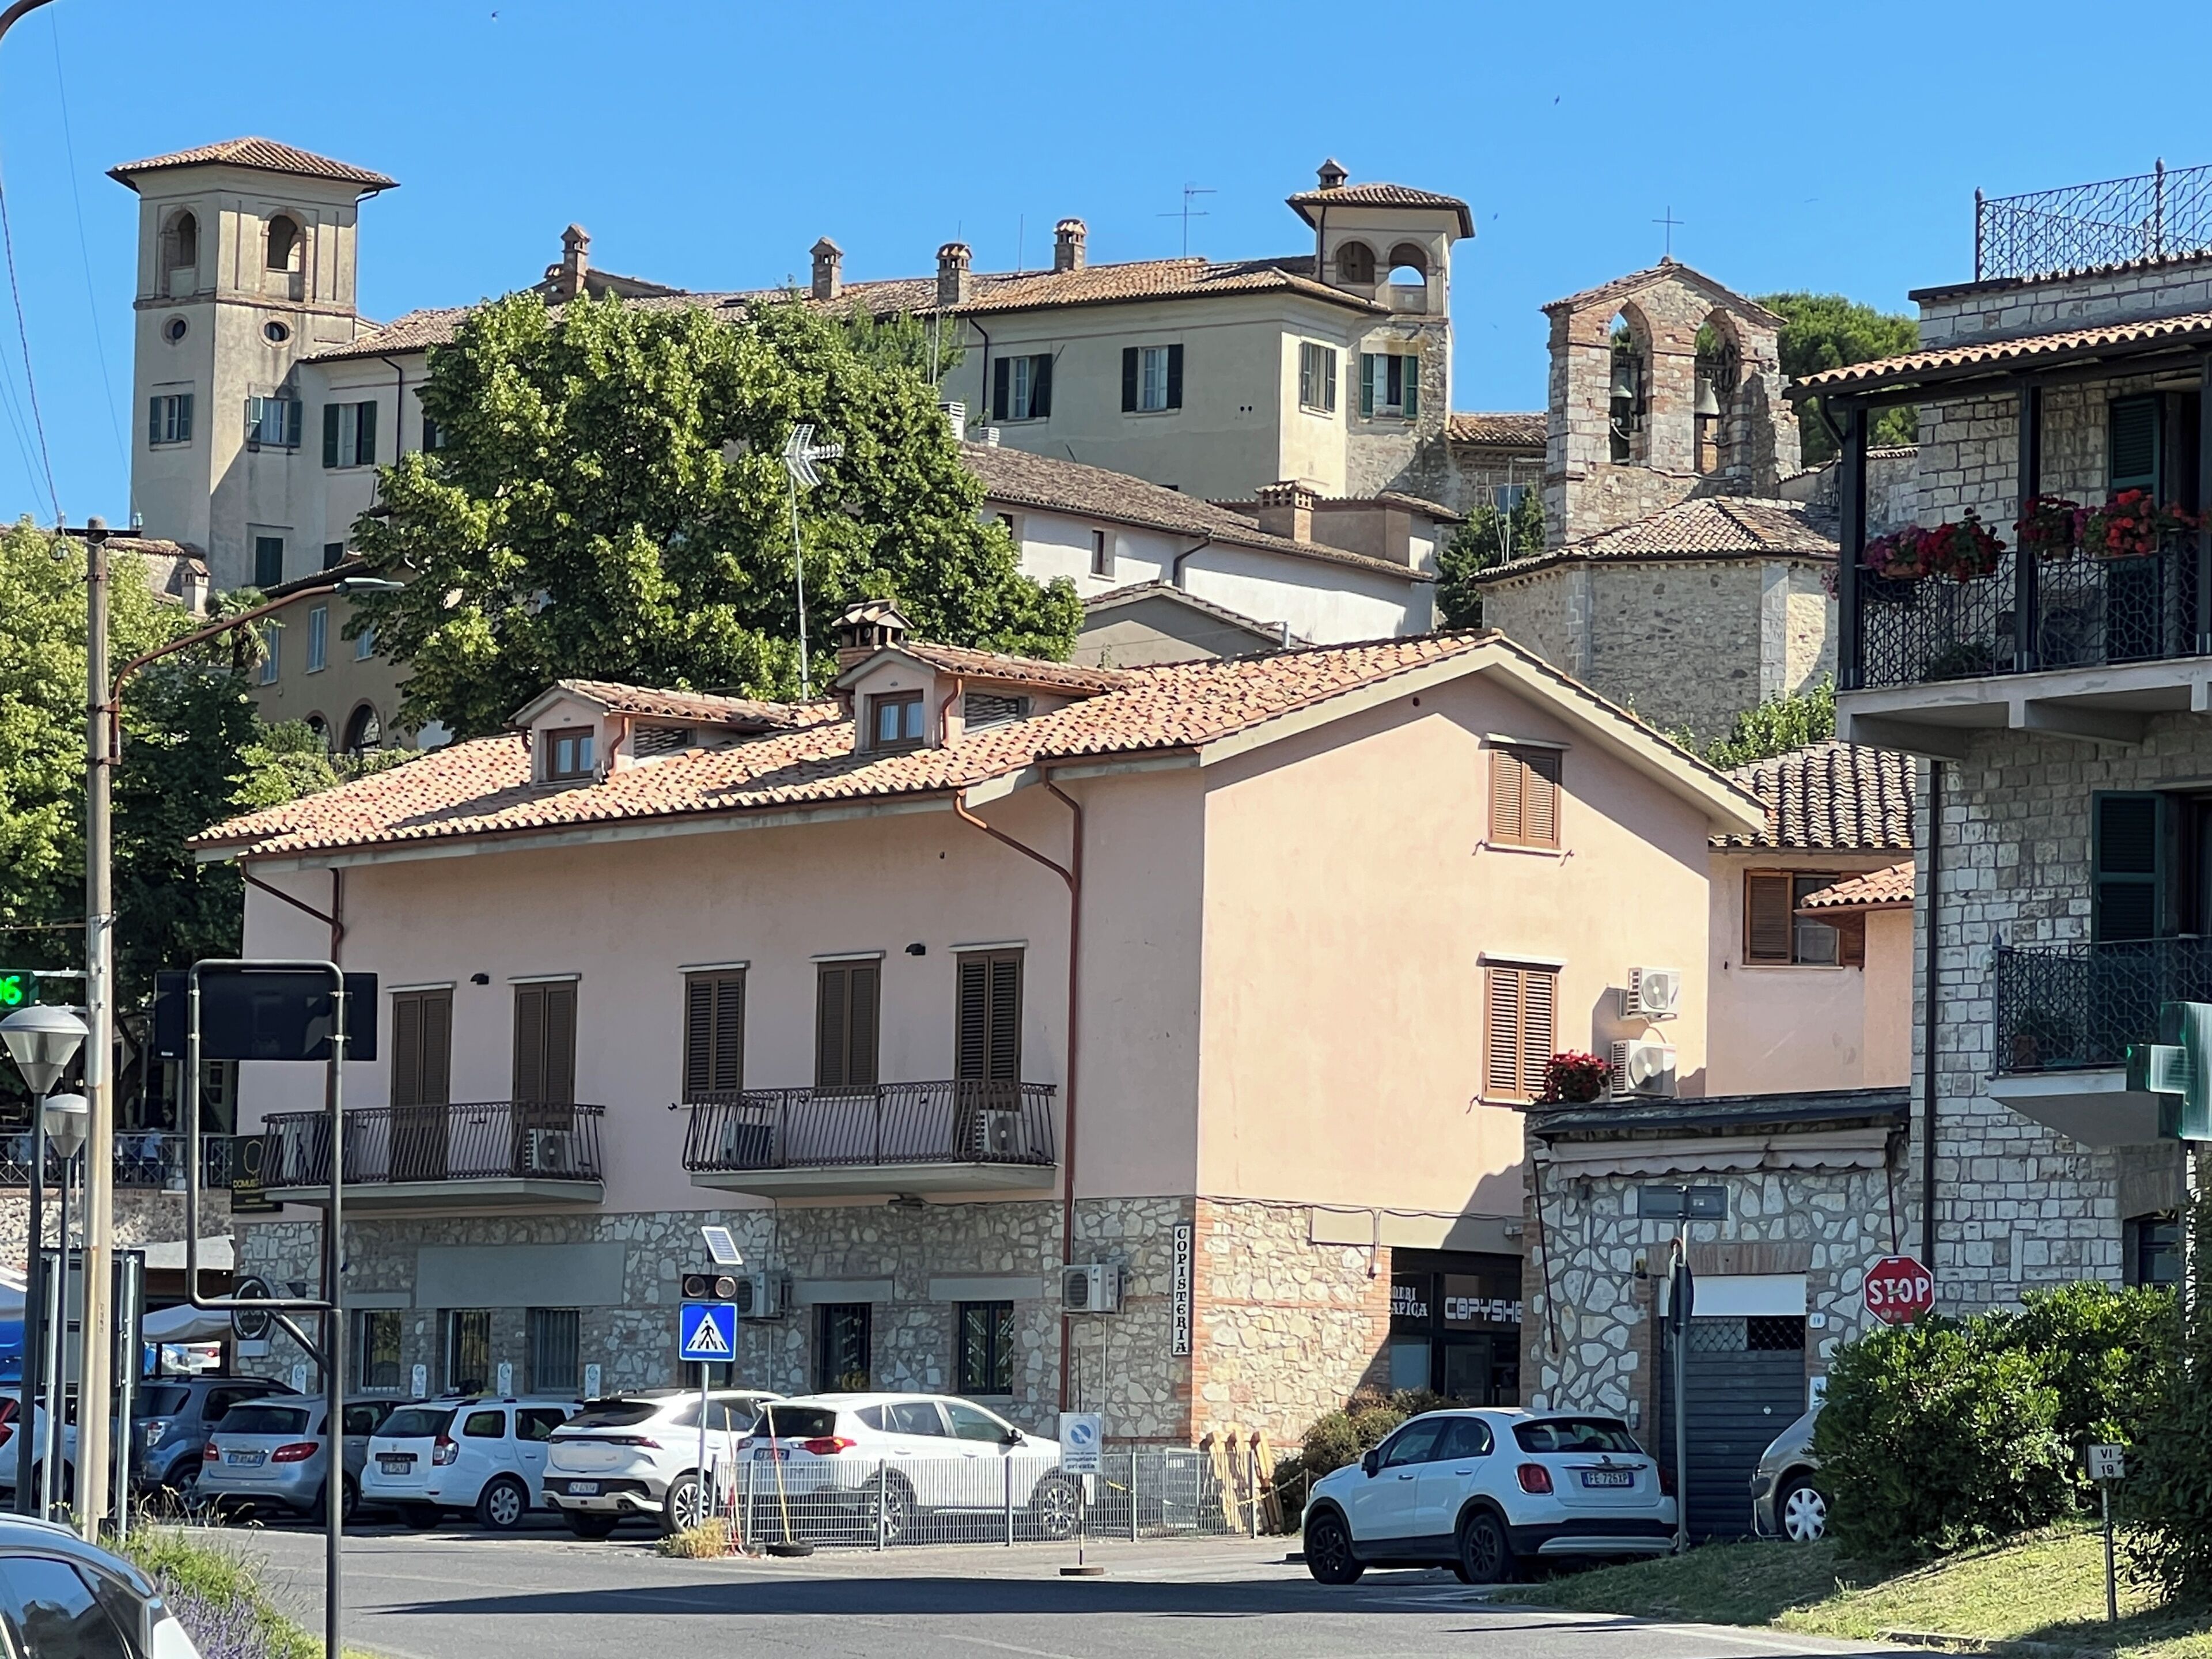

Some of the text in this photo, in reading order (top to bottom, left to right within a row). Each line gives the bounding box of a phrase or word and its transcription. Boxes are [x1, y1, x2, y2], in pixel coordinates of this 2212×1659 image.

[0, 975, 22, 1005] 6
[1174, 1228, 1187, 1353] COPISTERIA
[1869, 1277, 1929, 1305] STOP
[2101, 1449, 2112, 1459] VI
[1590, 1474, 1599, 1484] FE
[2101, 1464, 2113, 1475] 19
